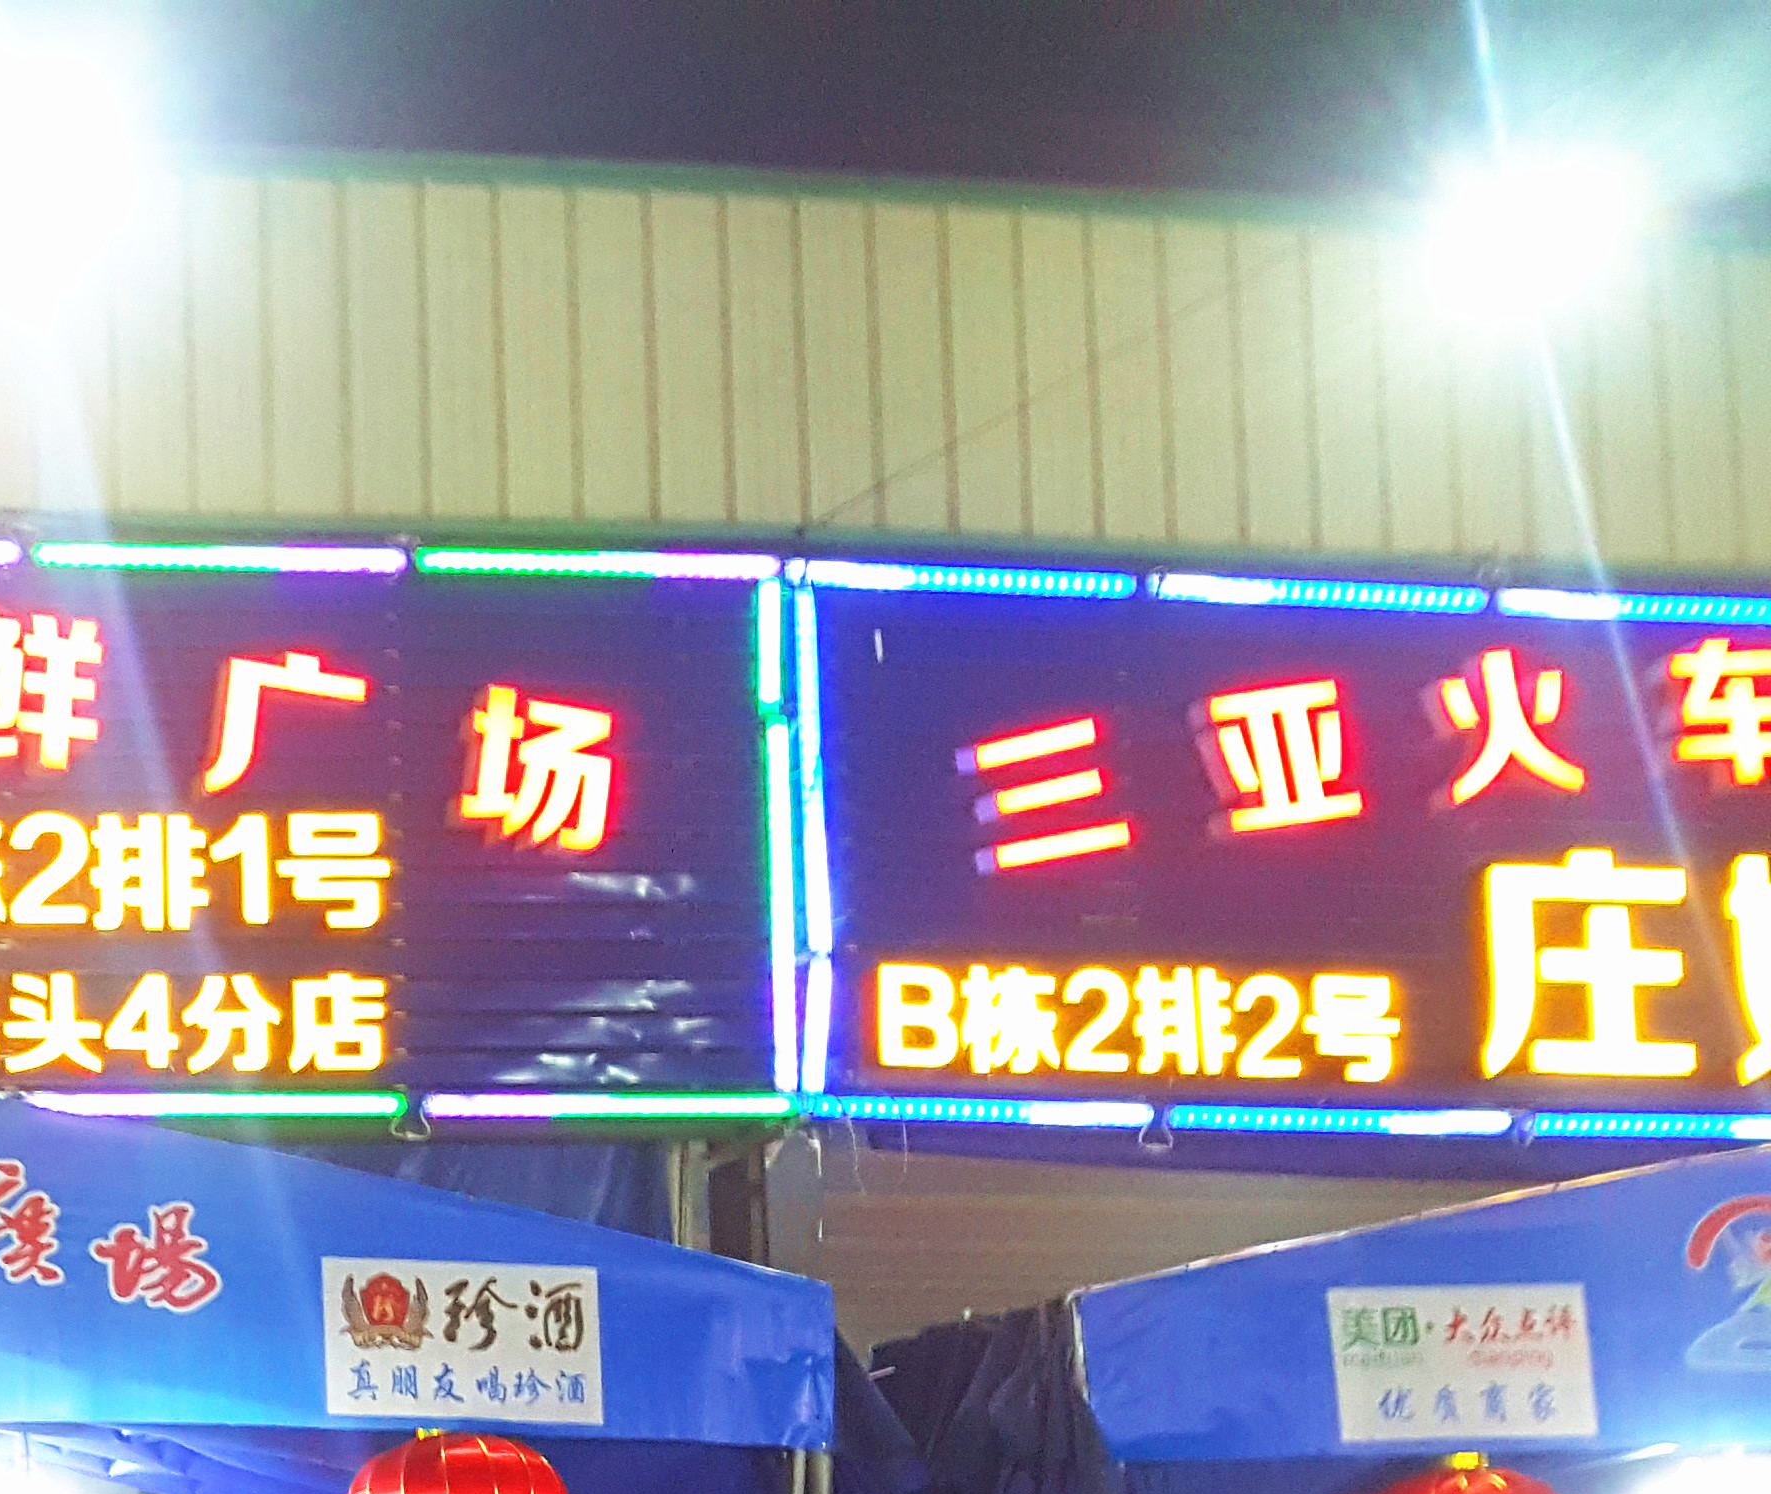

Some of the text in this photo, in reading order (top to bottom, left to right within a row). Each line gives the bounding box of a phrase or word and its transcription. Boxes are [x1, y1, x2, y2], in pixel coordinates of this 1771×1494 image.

[875, 962, 1401, 1085] B栋2排2号
[442, 1276, 584, 1351] 珍酒
[347, 1359, 586, 1404] 真朋友喝珍酒
